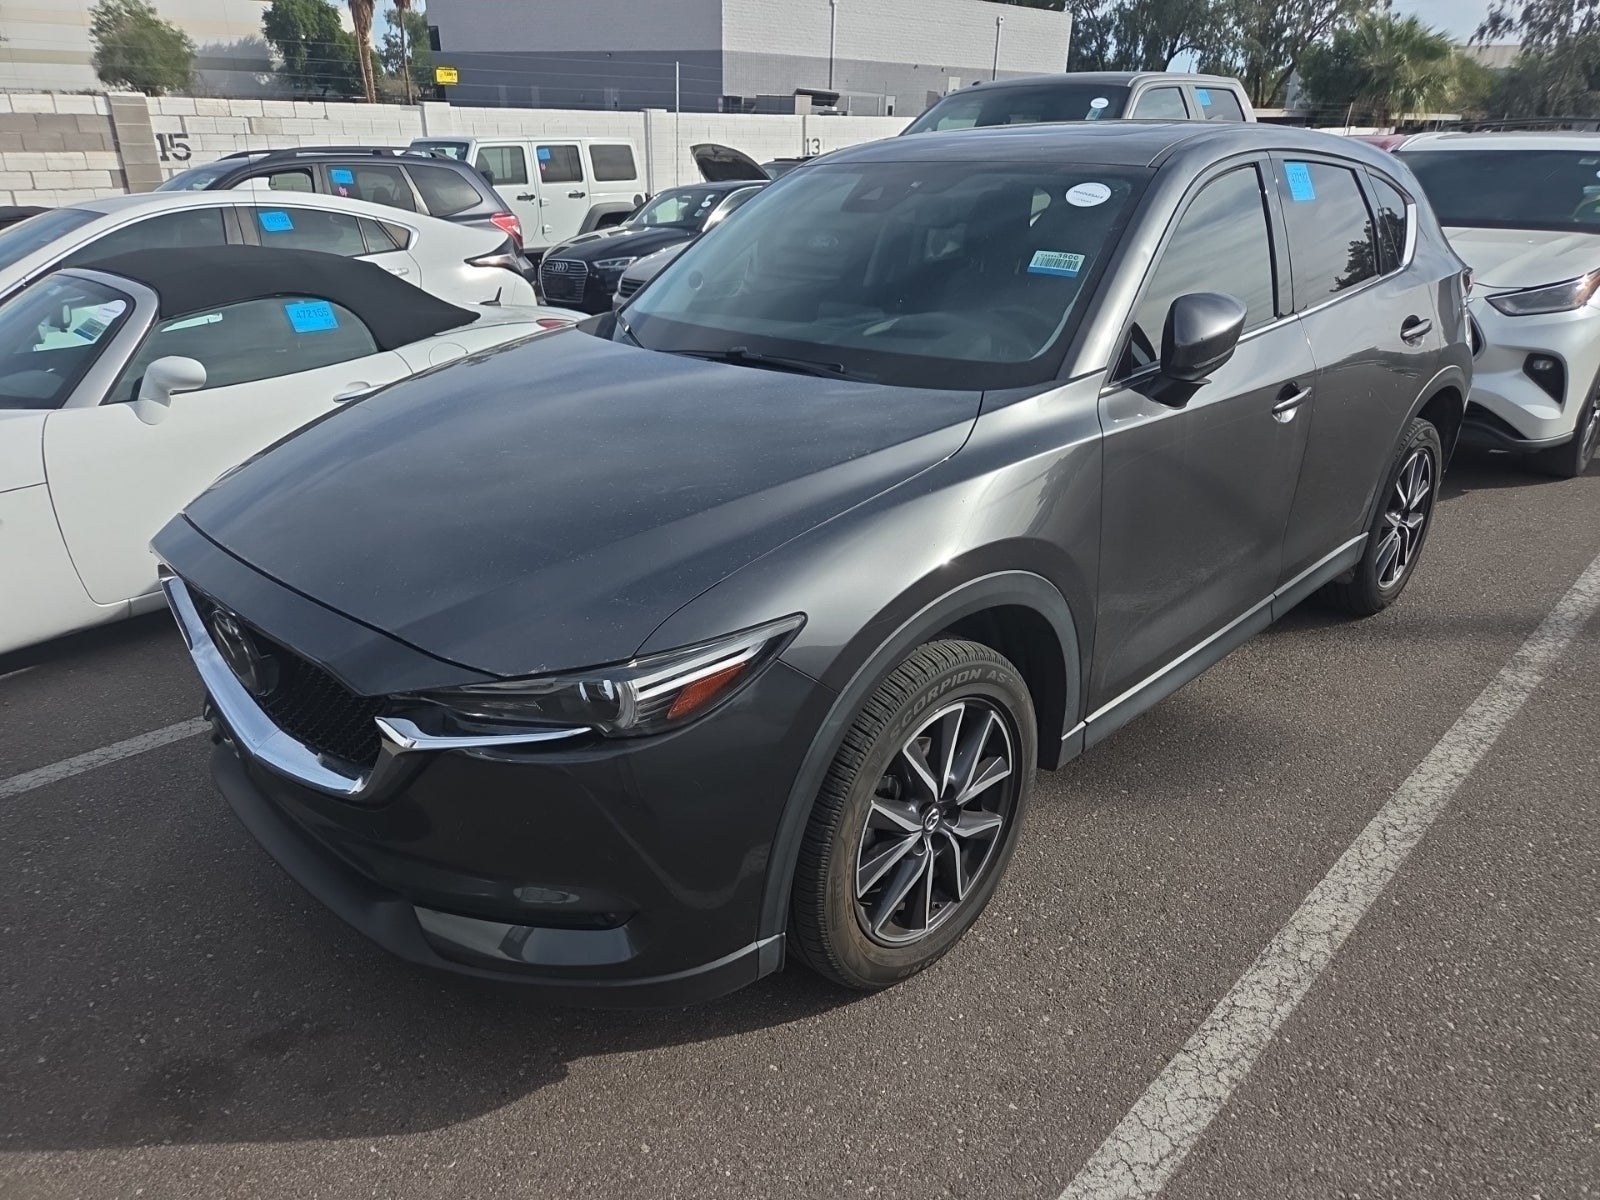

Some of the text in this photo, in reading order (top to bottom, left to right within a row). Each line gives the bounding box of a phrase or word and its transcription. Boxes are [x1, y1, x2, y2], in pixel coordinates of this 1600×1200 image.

[156, 133, 192, 162] 15
[806, 137, 821, 156] 13
[889, 668, 982, 739] SCORPION
